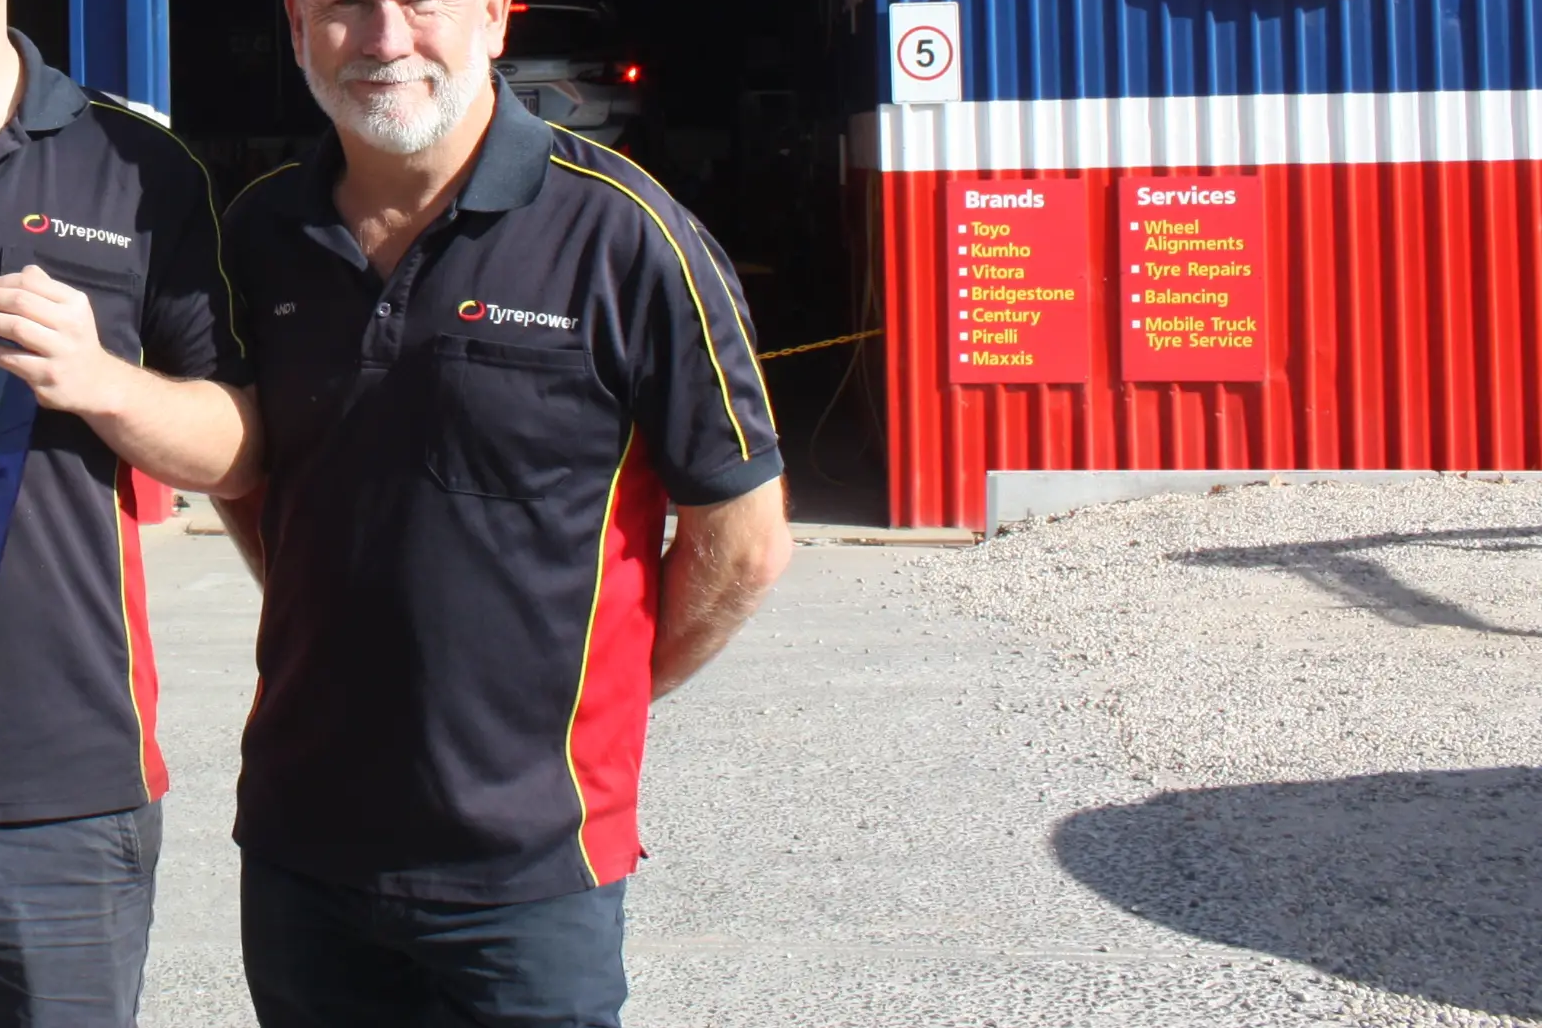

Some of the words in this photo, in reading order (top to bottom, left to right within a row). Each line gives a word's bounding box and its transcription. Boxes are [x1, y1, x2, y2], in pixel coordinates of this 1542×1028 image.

[915, 40, 935, 68] 5
[965, 189, 1045, 209] Brands
[1136, 186, 1236, 206] Services
[50, 218, 132, 249] Tyrepower
[971, 222, 1010, 238] Toyo
[1144, 220, 1199, 235] Wheel
[971, 244, 1031, 258] Kumho
[1144, 237, 1244, 254] Alignments
[971, 265, 1025, 279] Vitora
[1145, 262, 1181, 279] Tyre
[1188, 262, 1251, 279] Repairs
[971, 286, 1075, 304] Bridgestone
[1145, 289, 1229, 307] Balancing
[273, 302, 298, 316] ANDY
[486, 304, 579, 330] Tyrepower
[972, 308, 1041, 325] Century
[1145, 317, 1204, 332] Mobile
[1210, 317, 1257, 332] Truck
[972, 329, 1018, 344] Pirelli
[1146, 333, 1184, 351] Tyre
[1189, 333, 1253, 348] Service
[972, 351, 1034, 365] Maxxis
